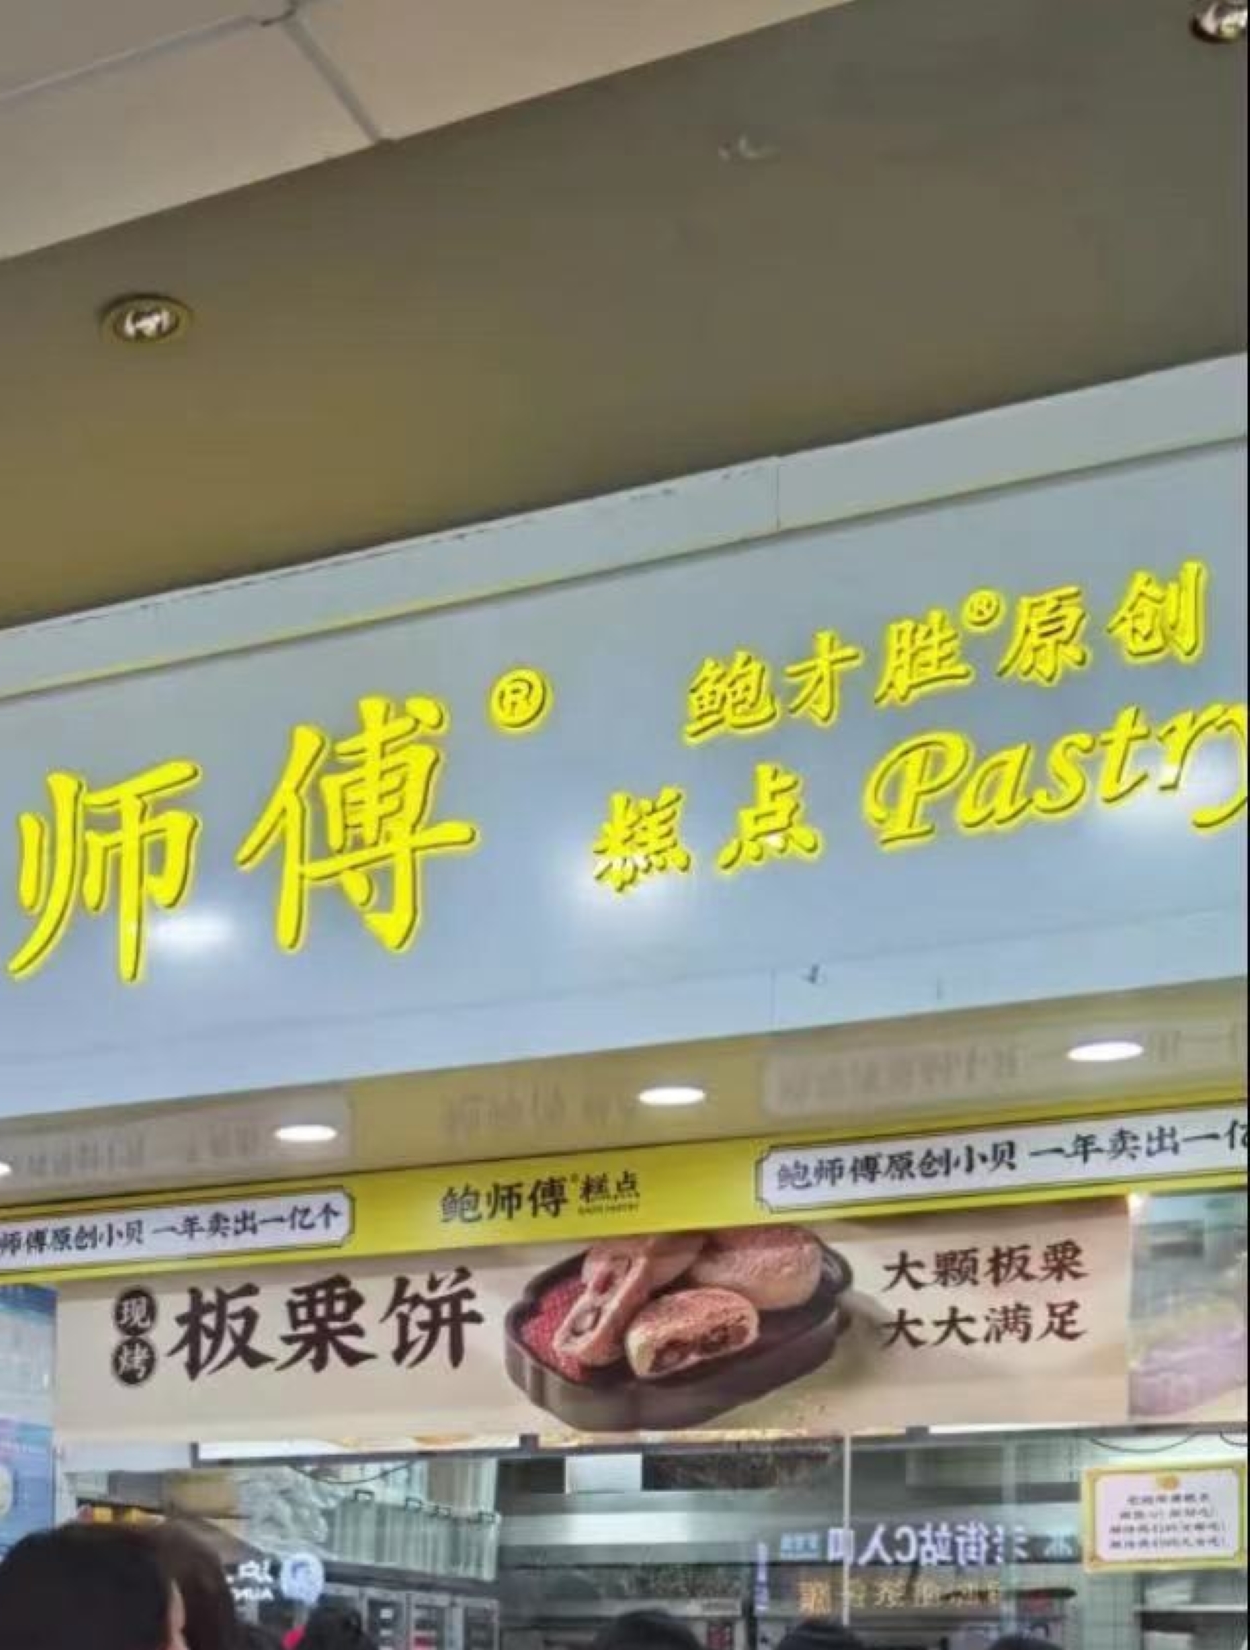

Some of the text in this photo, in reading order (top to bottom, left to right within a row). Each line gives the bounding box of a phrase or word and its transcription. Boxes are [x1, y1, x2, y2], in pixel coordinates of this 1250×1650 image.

[592, 762, 820, 891] 糕点
[777, 1140, 1018, 1191] 鲍师傅原创小贝
[152, 1202, 341, 1241] 一年卖出一亿个
[881, 1239, 1089, 1292] 大颗板栗
[116, 1291, 153, 1381] 现烤
[168, 1266, 484, 1381] 板栗饼
[881, 1299, 1088, 1349] 大大满足
